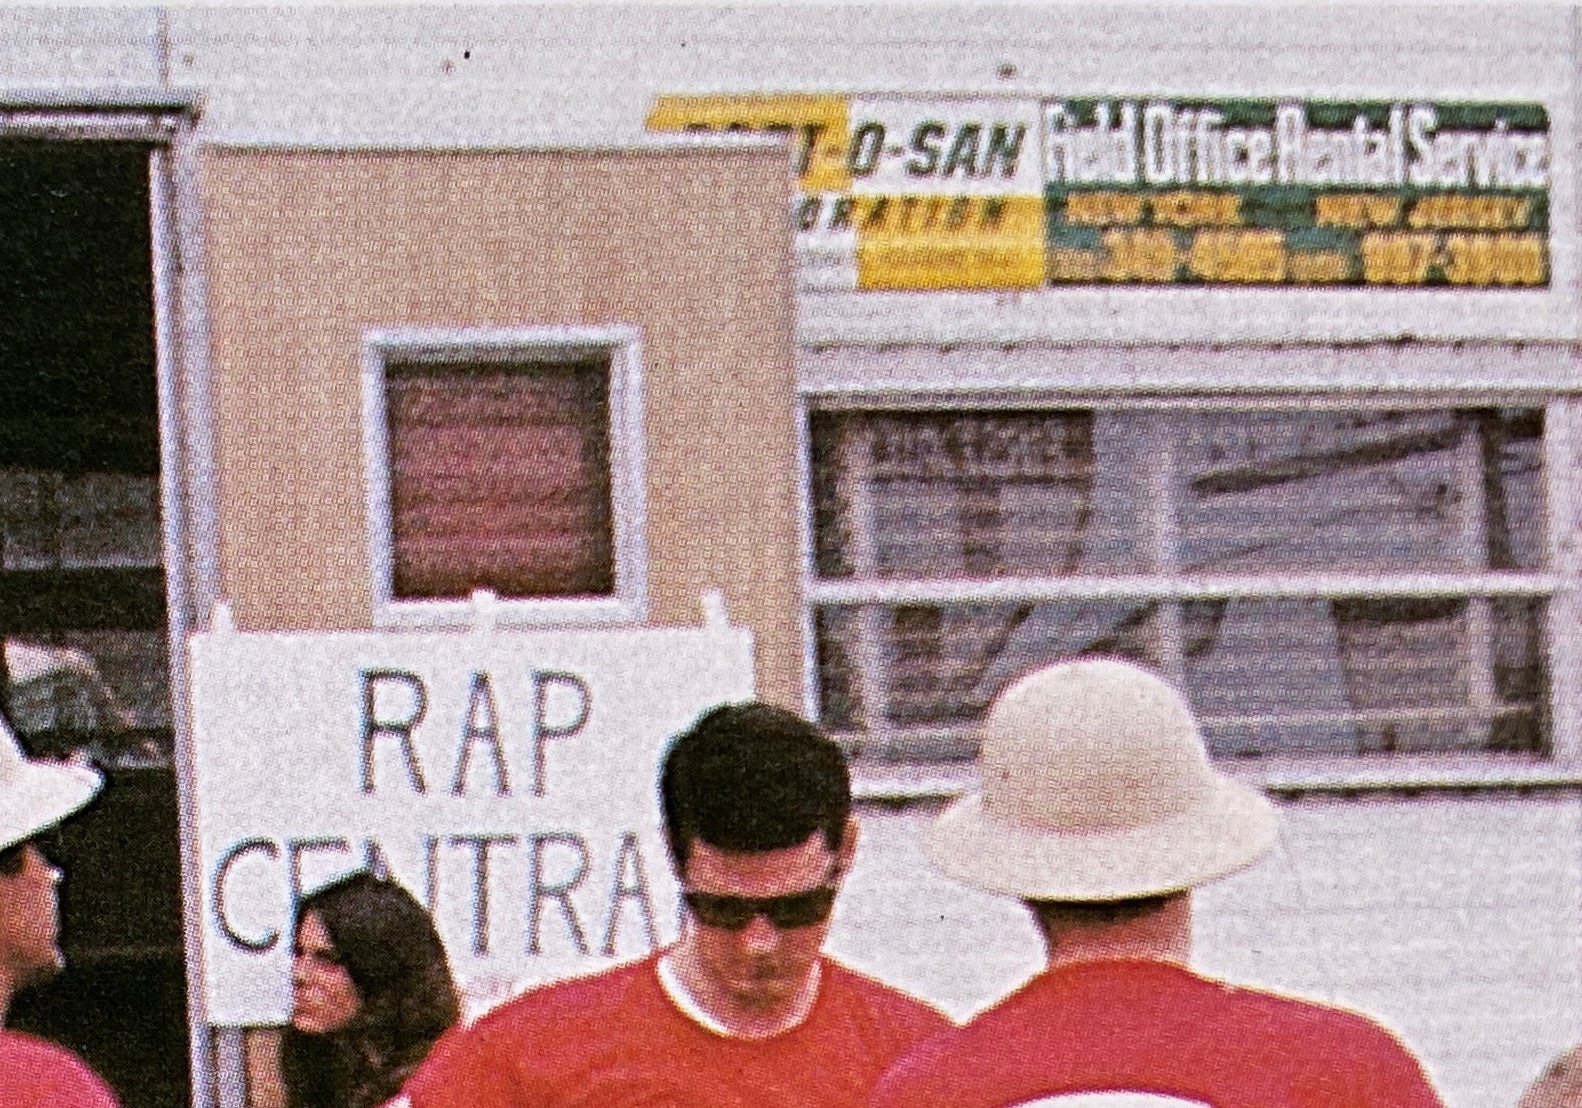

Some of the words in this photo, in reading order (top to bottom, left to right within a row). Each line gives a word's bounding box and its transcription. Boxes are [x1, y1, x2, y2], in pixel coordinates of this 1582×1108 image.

[684, 120, 1026, 179] T-O-SAN
[1045, 102, 1136, 183] Field
[1143, 103, 1272, 184] Office
[1275, 103, 1404, 184] Rental
[1407, 104, 1548, 187] Service
[358, 667, 594, 799] RAP
